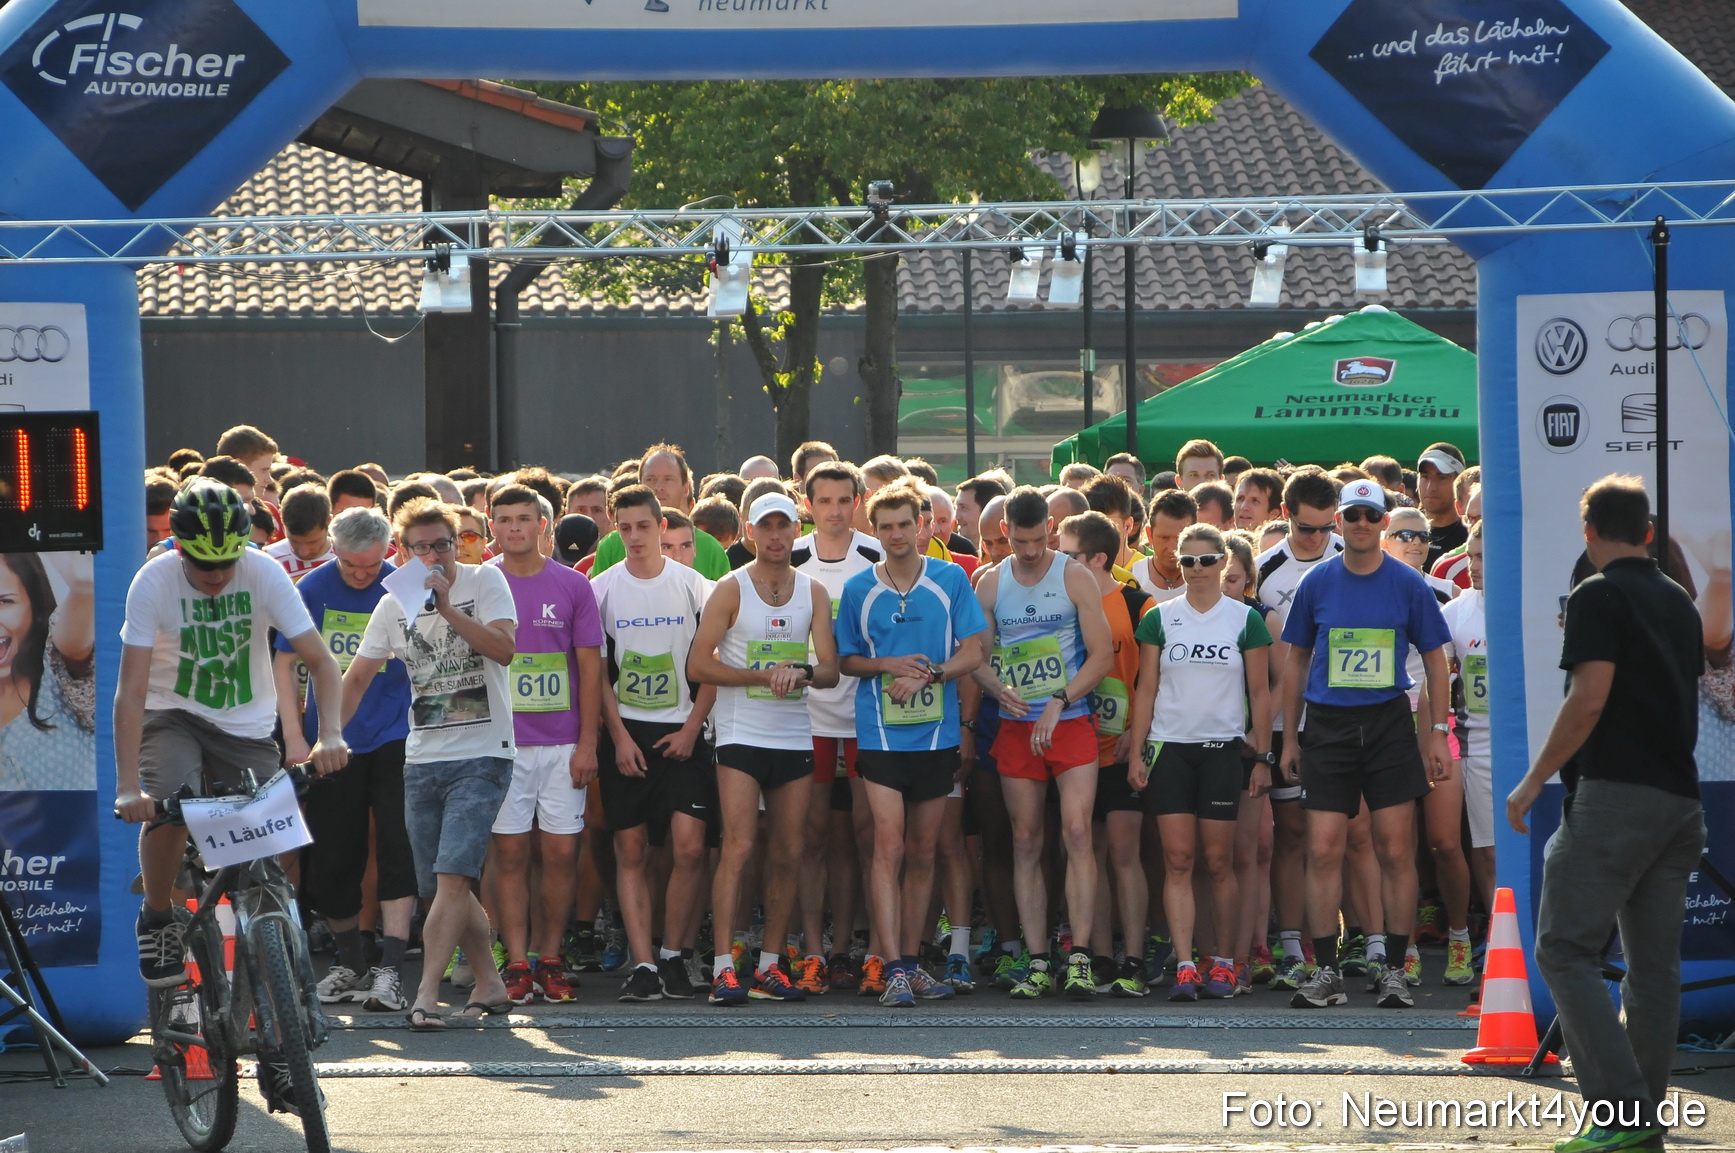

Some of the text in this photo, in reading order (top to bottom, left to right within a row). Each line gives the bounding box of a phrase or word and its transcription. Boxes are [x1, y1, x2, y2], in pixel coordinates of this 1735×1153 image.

[1372, 29, 1418, 57] und
[1425, 22, 1470, 47] das
[1474, 16, 1570, 42] Lächeln
[68, 43, 246, 77] Fischer
[1433, 42, 1564, 84] fährt mit!
[83, 81, 230, 97] AUTOMOBILE
[1609, 362, 1655, 375] Audi
[1285, 393, 1437, 405] Neumarkter
[1254, 403, 1460, 419] Lammsbräu
[1547, 412, 1577, 438] FIAT
[542, 603, 557, 619] K
[1002, 614, 1062, 626] SCHABMÜLLER
[616, 616, 684, 629] DELPHI
[330, 632, 361, 656] 66
[1191, 644, 1231, 660] RSC
[435, 656, 477, 674] WAVES
[1338, 649, 1381, 672] 721
[174, 644, 253, 710] ICH
[1006, 657, 1062, 688] 1249
[434, 681, 445, 692] OF
[447, 674, 484, 691] SUMMER
[517, 673, 561, 697] 610
[626, 672, 669, 696] 212
[1473, 675, 1488, 699] 5
[205, 815, 294, 850] 1. Läufer
[0, 880, 54, 891] OBILE
[27, 901, 87, 918] Lächeln
[1693, 910, 1727, 925] mit!
[47, 917, 83, 933] mit!
